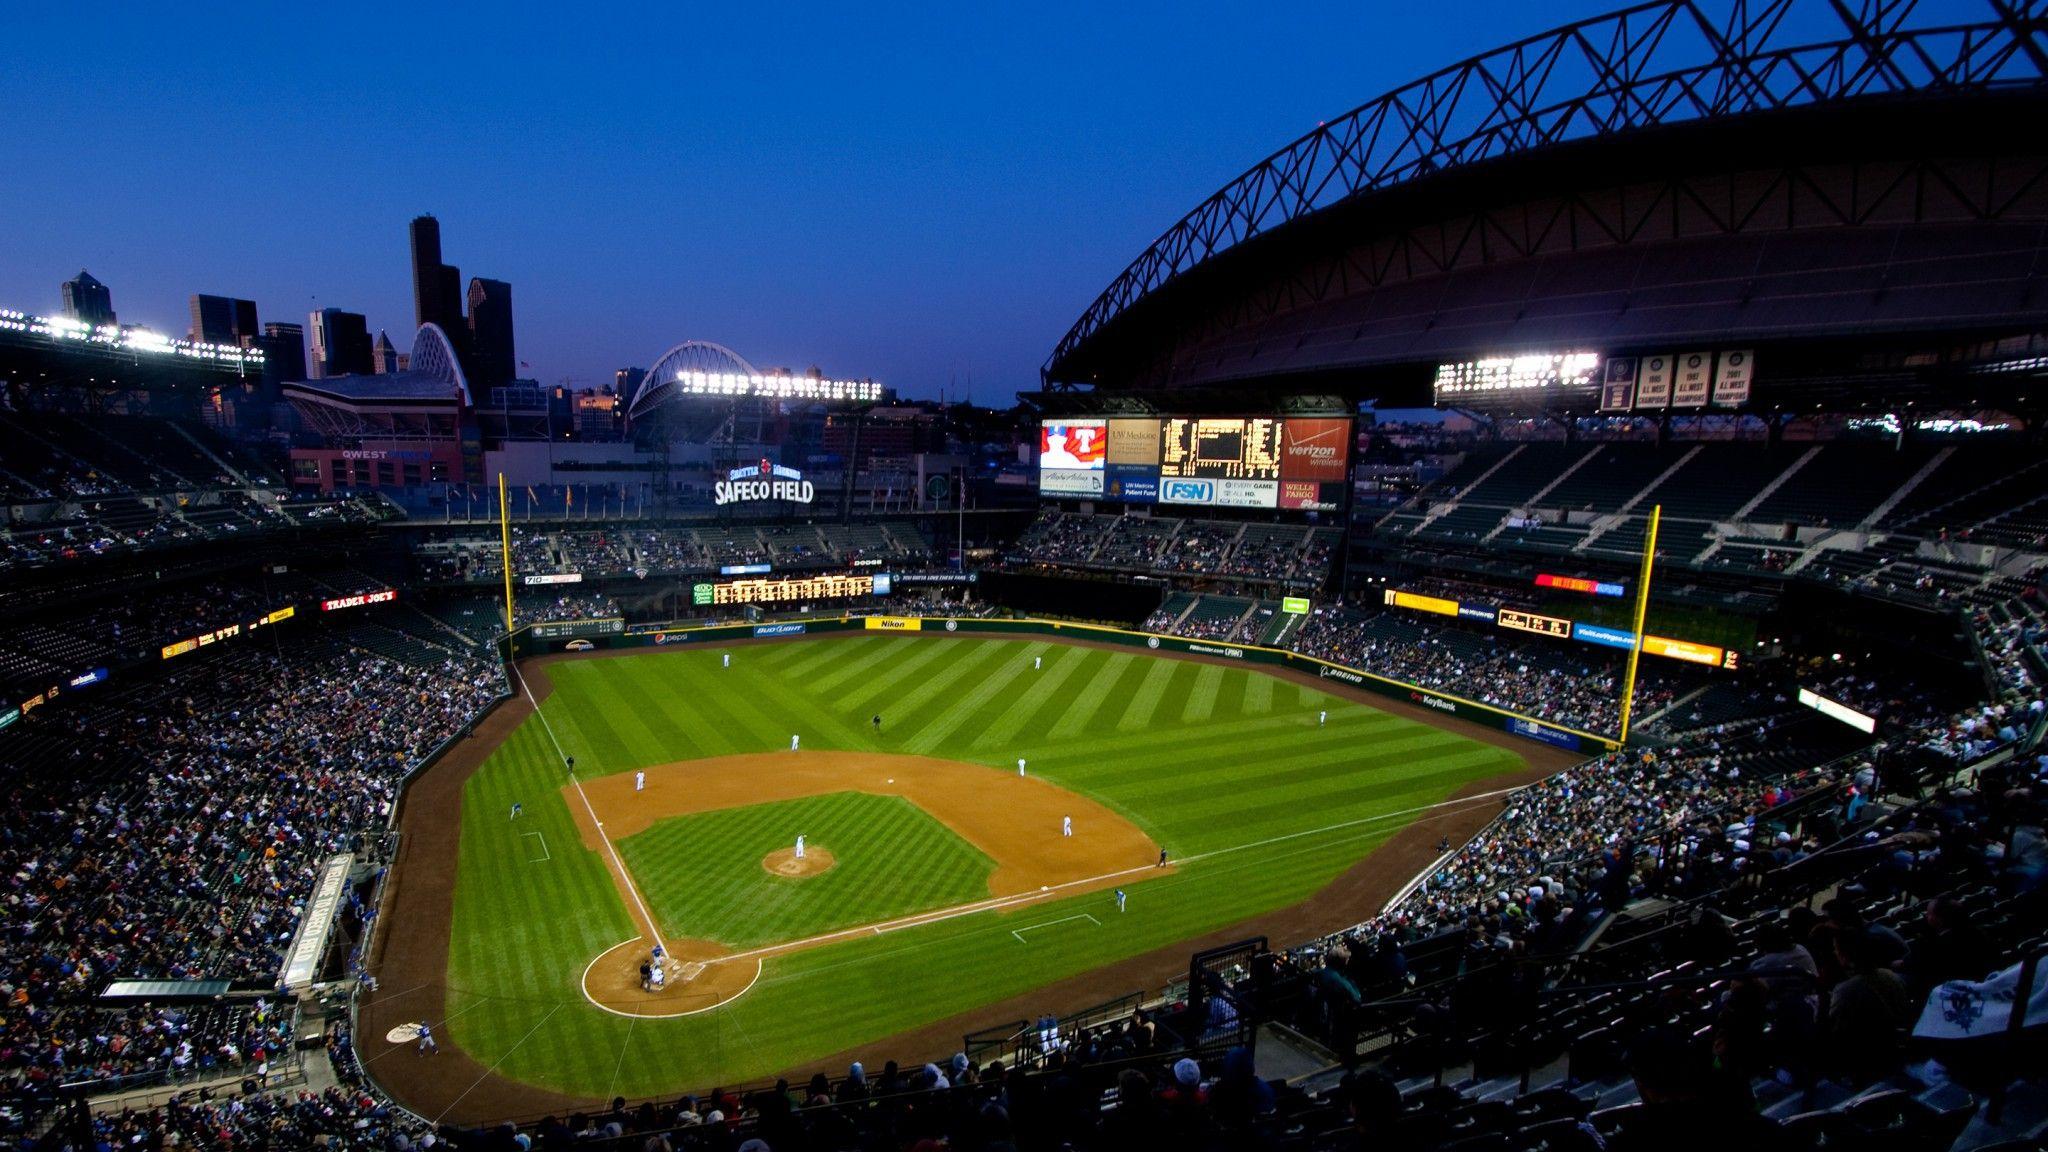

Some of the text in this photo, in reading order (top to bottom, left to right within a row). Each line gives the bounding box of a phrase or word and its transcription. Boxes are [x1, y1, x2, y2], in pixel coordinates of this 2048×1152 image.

[1688, 383, 1703, 391] WEST
[1729, 381, 1745, 389] WEST
[1639, 396, 1668, 404] CHAMPIONS
[1675, 394, 1706, 403] CHAMPIONS
[1715, 392, 1748, 400] CHAMPIONS
[1112, 430, 1158, 440] UW Medicine
[343, 450, 387, 459] QWEST
[1288, 445, 1336, 457] verizon
[1170, 483, 1206, 500] FSN
[1285, 483, 1315, 491] WELLS
[715, 481, 814, 505] SAFECO FIELD
[1285, 490, 1314, 498] FARGO
[527, 576, 543, 584] 710
[326, 591, 394, 611] TRADER JOE'S
[881, 620, 905, 628] Nikon
[666, 633, 688, 643] pepsi
[1330, 668, 1363, 683] BOEING
[1422, 694, 1456, 712] KeyBank
